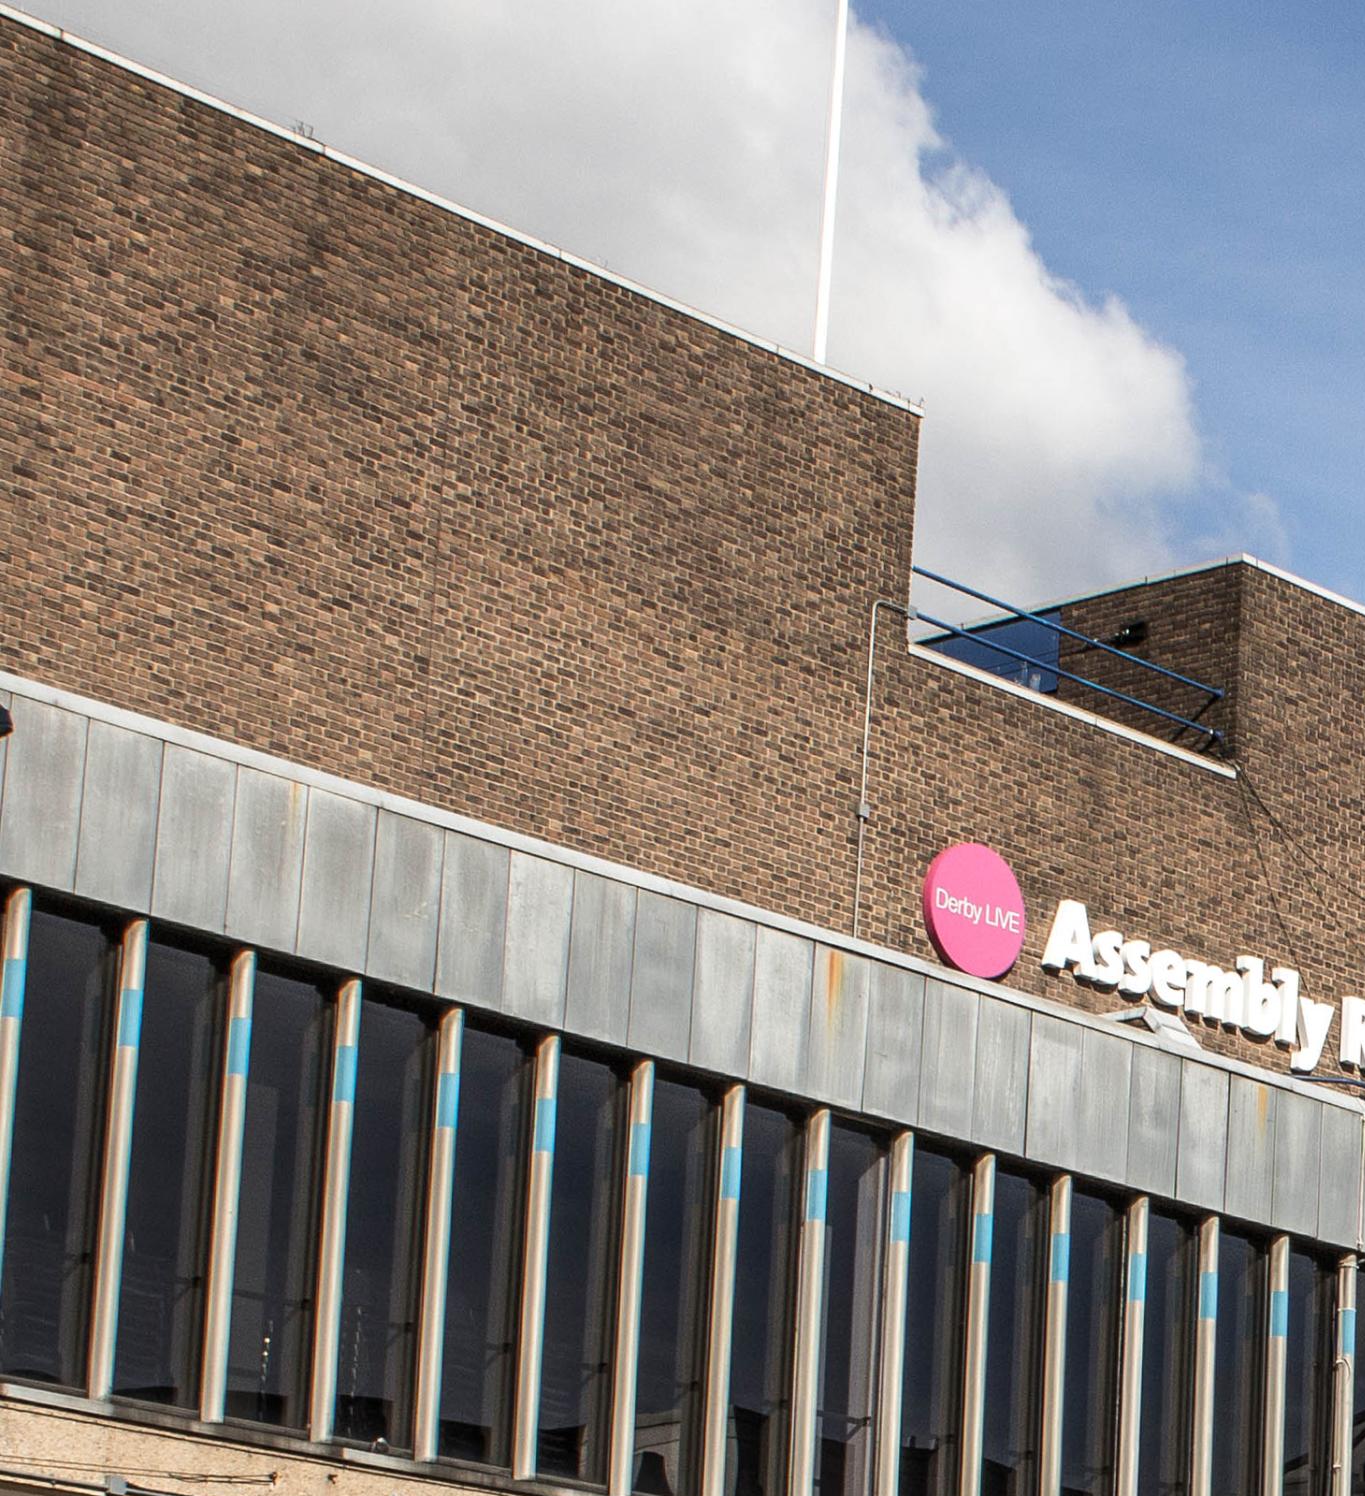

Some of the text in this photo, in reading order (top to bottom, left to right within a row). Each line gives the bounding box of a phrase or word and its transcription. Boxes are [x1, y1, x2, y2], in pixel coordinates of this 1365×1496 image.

[935, 887, 1021, 934] Derby LIVE
[1041, 898, 1335, 1074] Assembly
